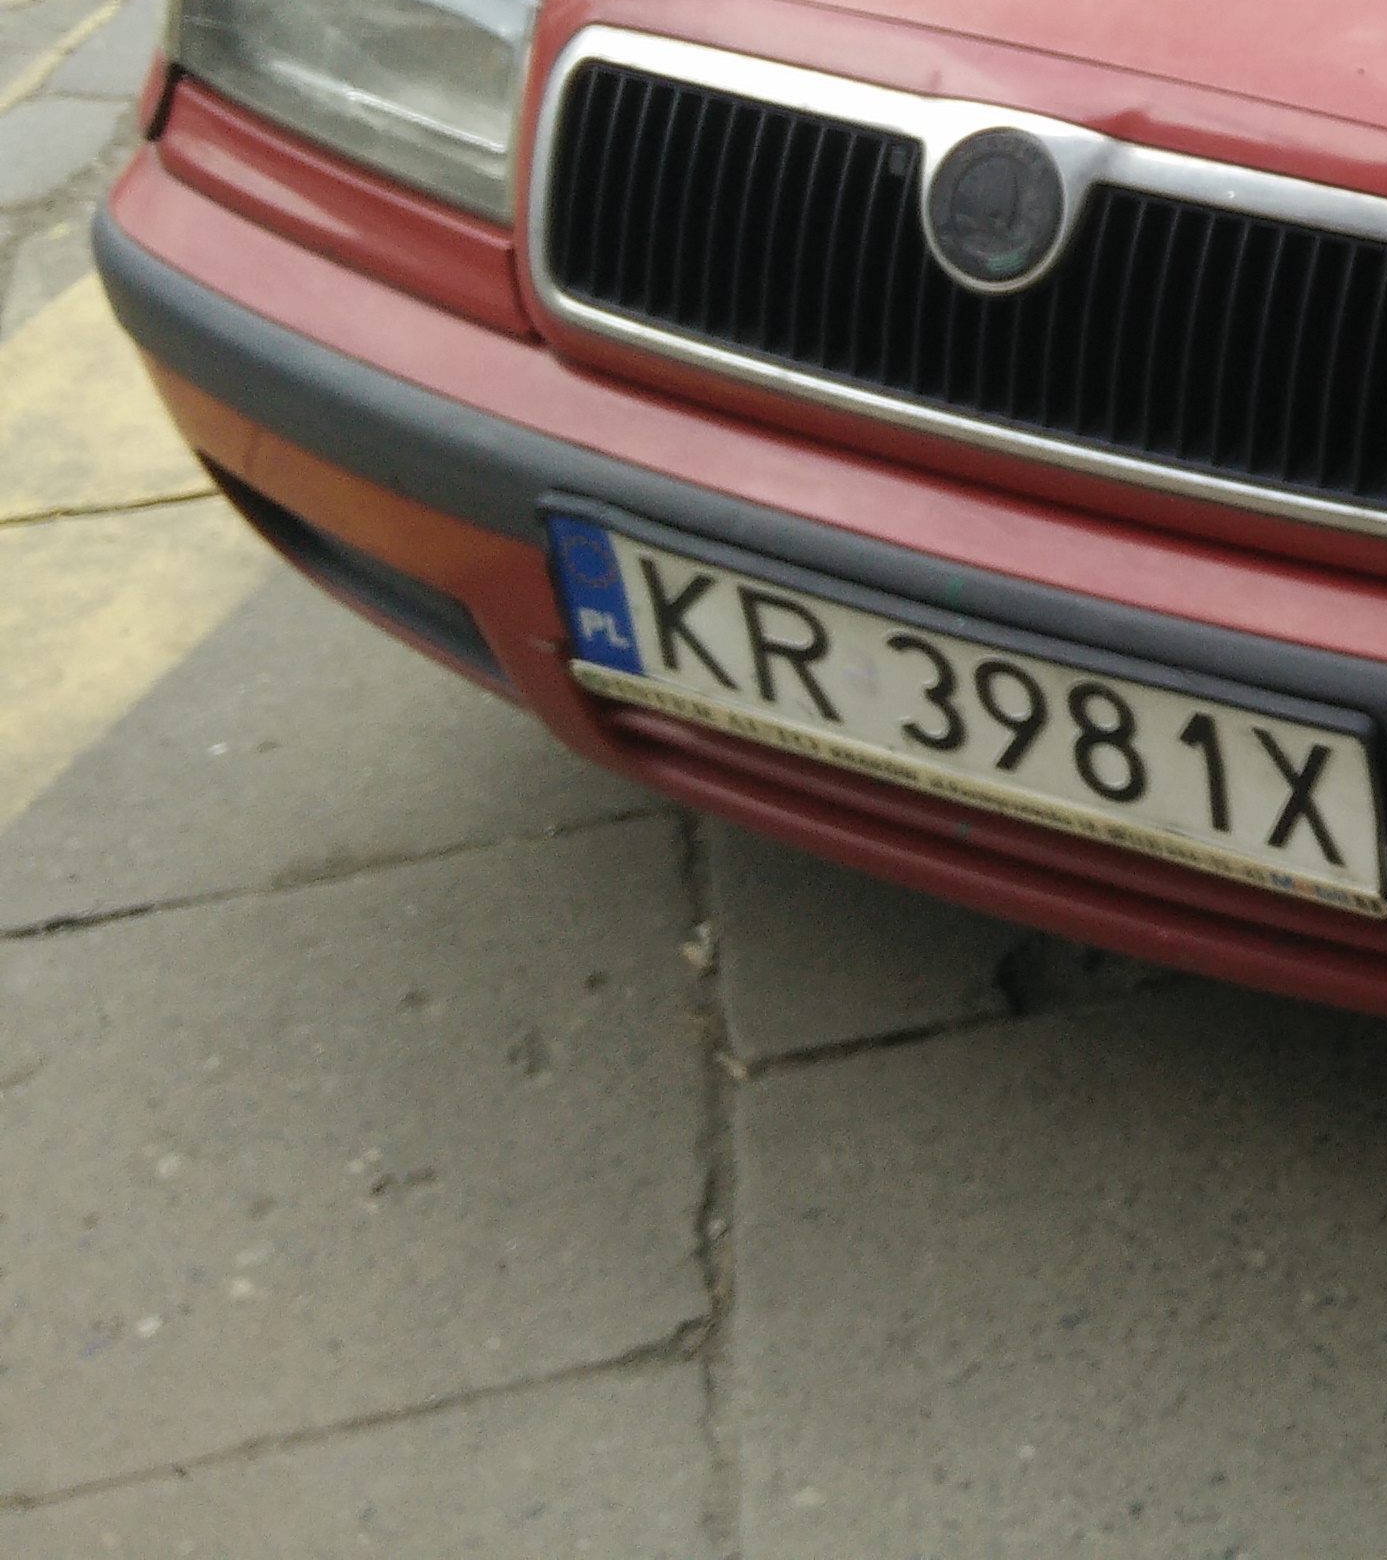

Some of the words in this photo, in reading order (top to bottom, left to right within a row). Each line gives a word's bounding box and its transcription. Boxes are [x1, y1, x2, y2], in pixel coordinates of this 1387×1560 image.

[578, 608, 629, 649] PL
[638, 557, 841, 722] KR
[887, 634, 1345, 867] 3981X
